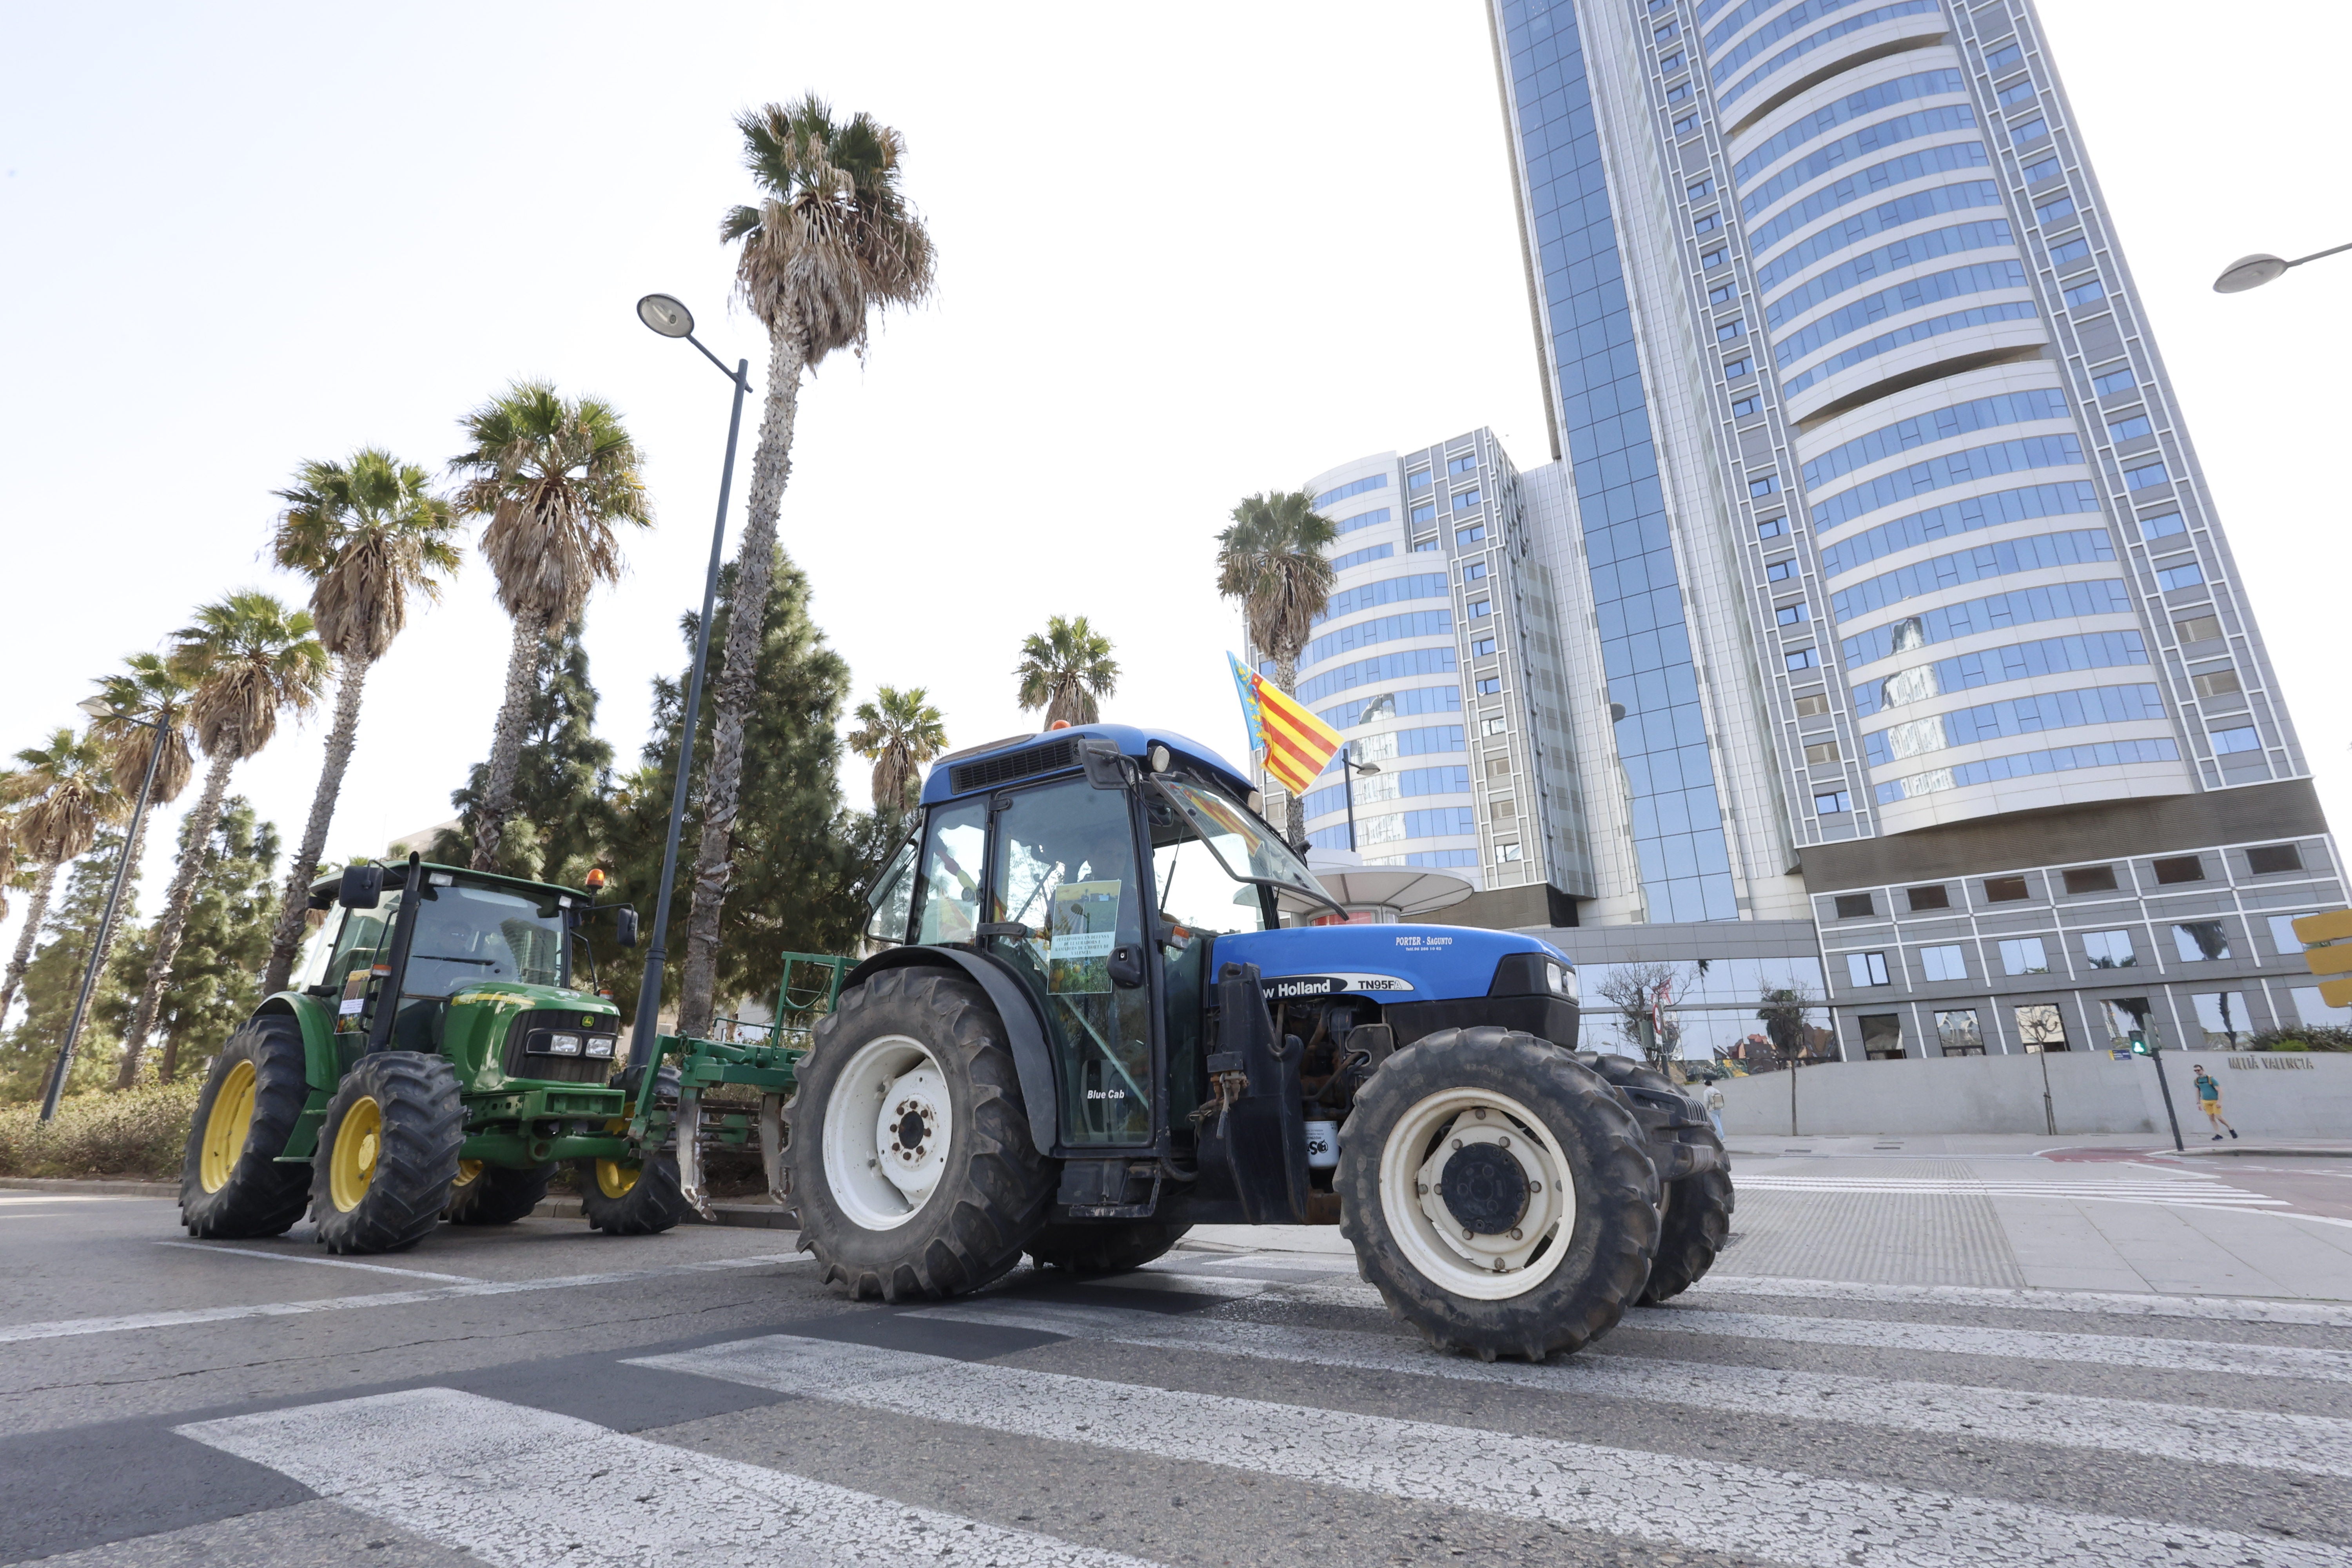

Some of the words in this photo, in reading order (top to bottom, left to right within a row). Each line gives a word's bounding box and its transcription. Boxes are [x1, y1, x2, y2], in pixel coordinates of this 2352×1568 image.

[1396, 936, 1421, 946] PORTER
[1426, 936, 1452, 945] SAGUNTO
[1278, 979, 1330, 997] Holland
[1087, 1090, 1106, 1099] Blue
[1108, 1089, 1125, 1099] Cab
